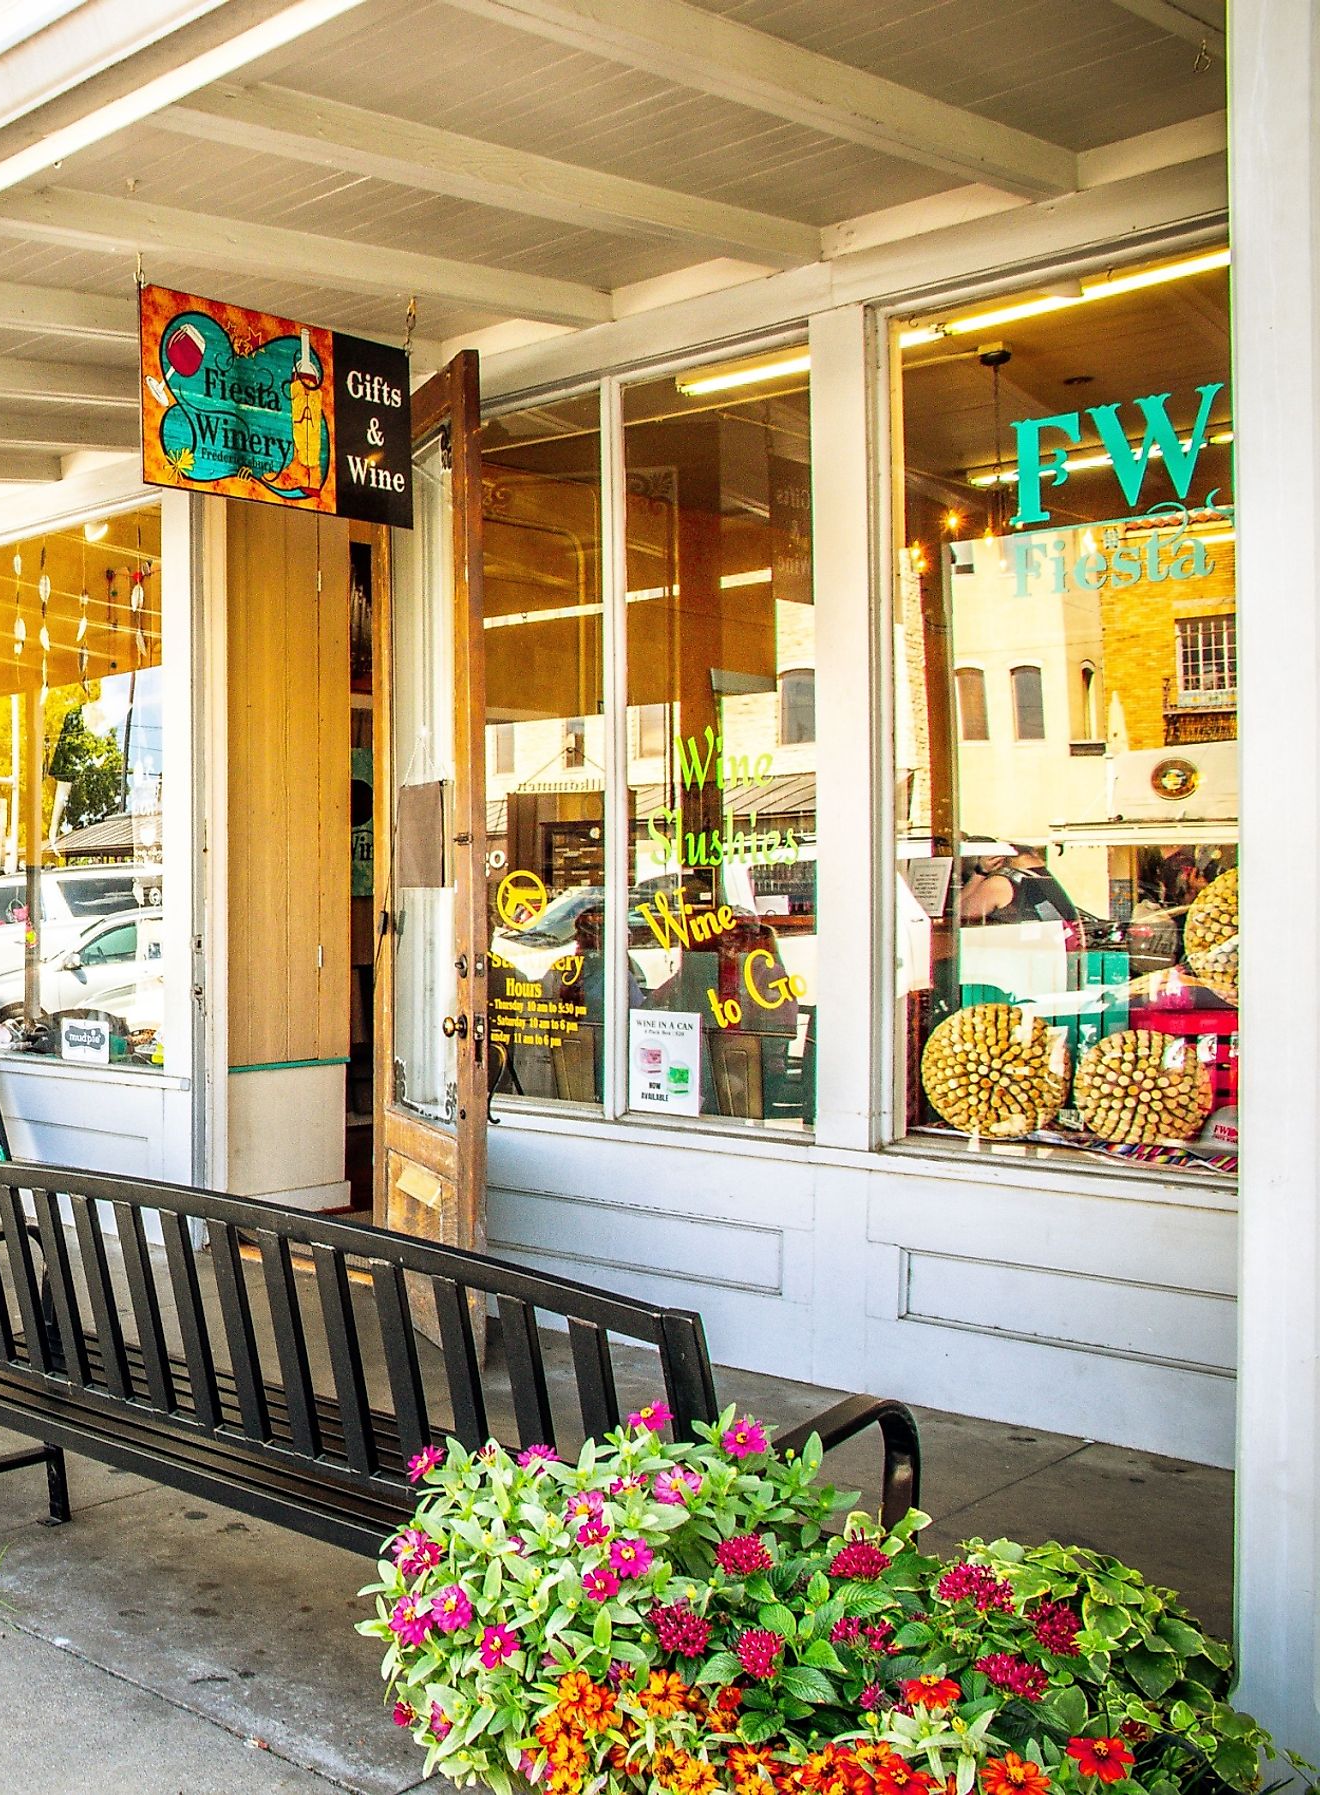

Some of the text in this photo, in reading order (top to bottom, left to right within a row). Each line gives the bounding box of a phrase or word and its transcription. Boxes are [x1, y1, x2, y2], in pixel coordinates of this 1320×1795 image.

[203, 366, 282, 412] Fiesta
[346, 369, 402, 408] Gifts
[194, 412, 294, 464] Winery
[366, 416, 385, 447] &
[346, 454, 406, 493] Wine
[1008, 382, 1225, 527] FW
[1012, 512, 1216, 599] Fiesta
[674, 724, 774, 792] Wine
[647, 806, 800, 867] Slushies
[634, 885, 737, 953] Wine
[505, 976, 543, 998] Hours
[706, 948, 808, 1029] to Go
[494, 998, 524, 1014] Thursday
[527, 1001, 537, 1012] 10
[537, 1004, 549, 1013] am
[549, 1001, 558, 1013] to
[575, 1005, 588, 1018] pm
[497, 1014, 579, 1034] Saturday 10 am to 6 pm
[636, 1019, 694, 1031] WINE IN A CAN
[514, 1032, 522, 1044] 11
[523, 1035, 534, 1045] am
[535, 1033, 543, 1045] to
[543, 1034, 550, 1046] 6
[550, 1037, 562, 1049] pm
[641, 1092, 669, 1102] AVAILABLE
